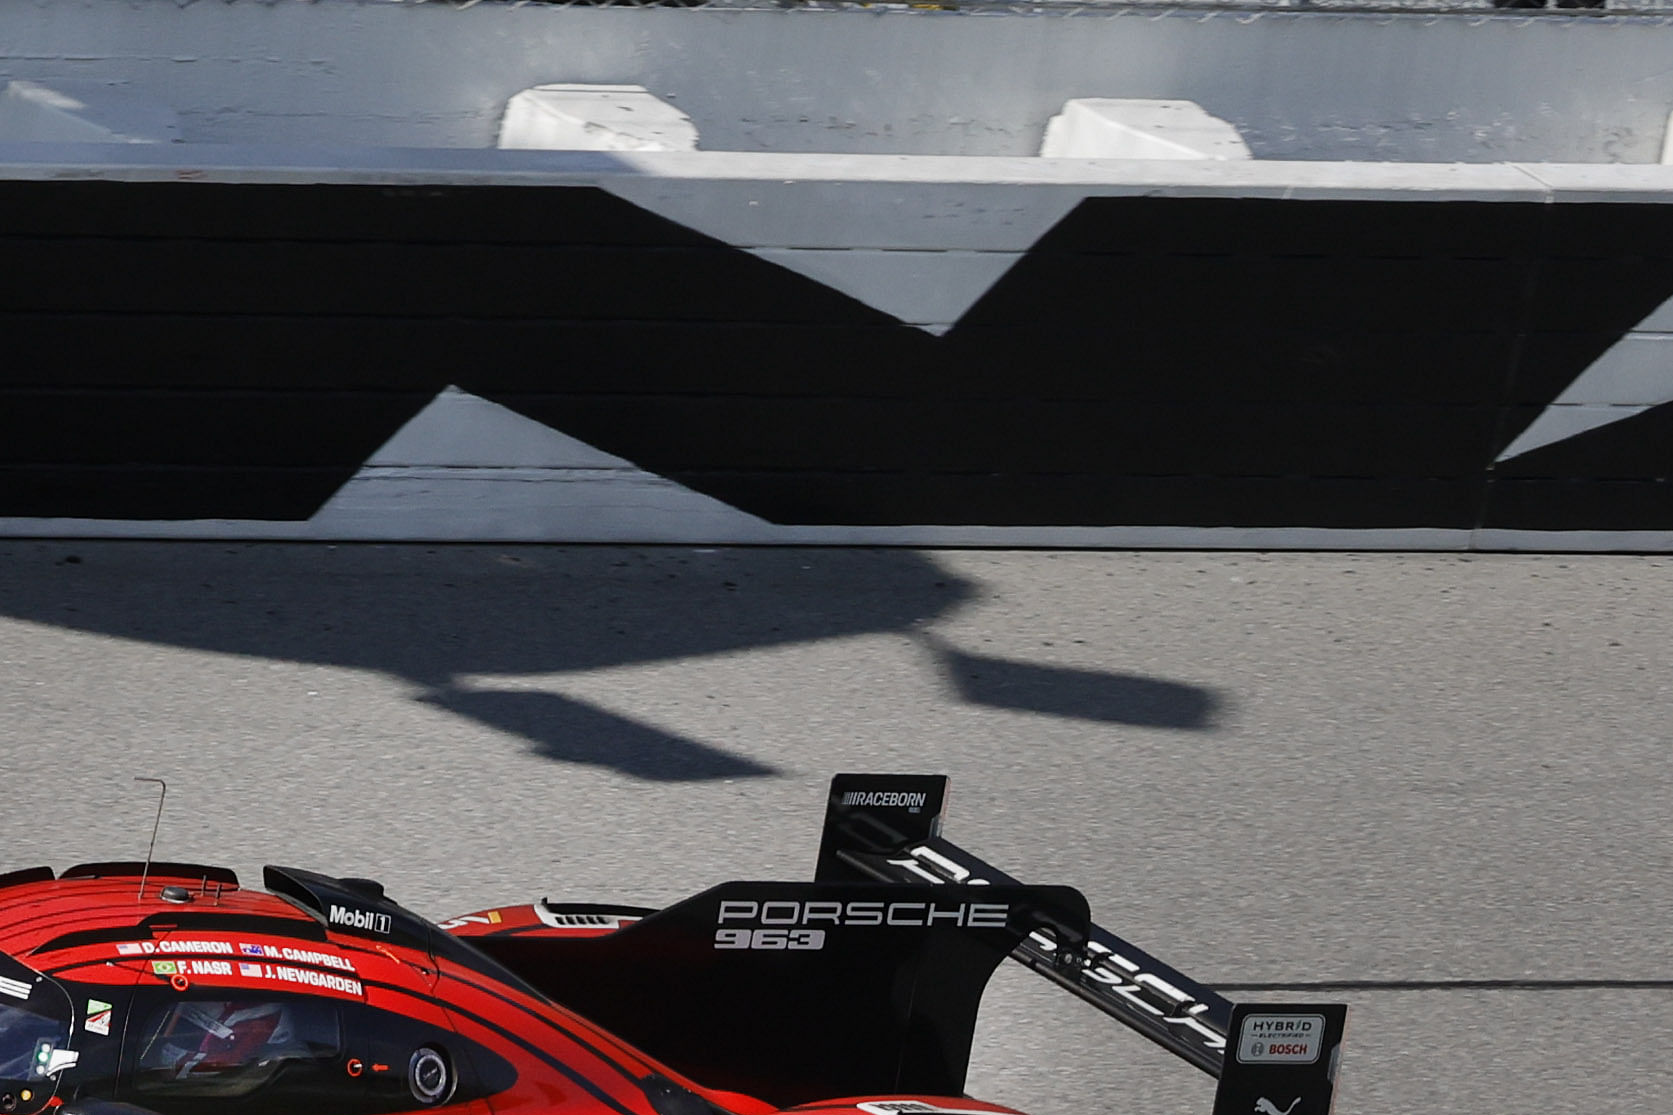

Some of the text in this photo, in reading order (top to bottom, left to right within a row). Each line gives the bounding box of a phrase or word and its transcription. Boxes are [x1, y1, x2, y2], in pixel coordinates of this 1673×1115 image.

[855, 791, 927, 807] RACEBORN
[329, 904, 374, 931] Mobil
[717, 900, 1010, 928] PORSCHE
[713, 929, 826, 950] 963
[1252, 1019, 1312, 1032] HYBRID
[1268, 1043, 1308, 1055] BOSCH
